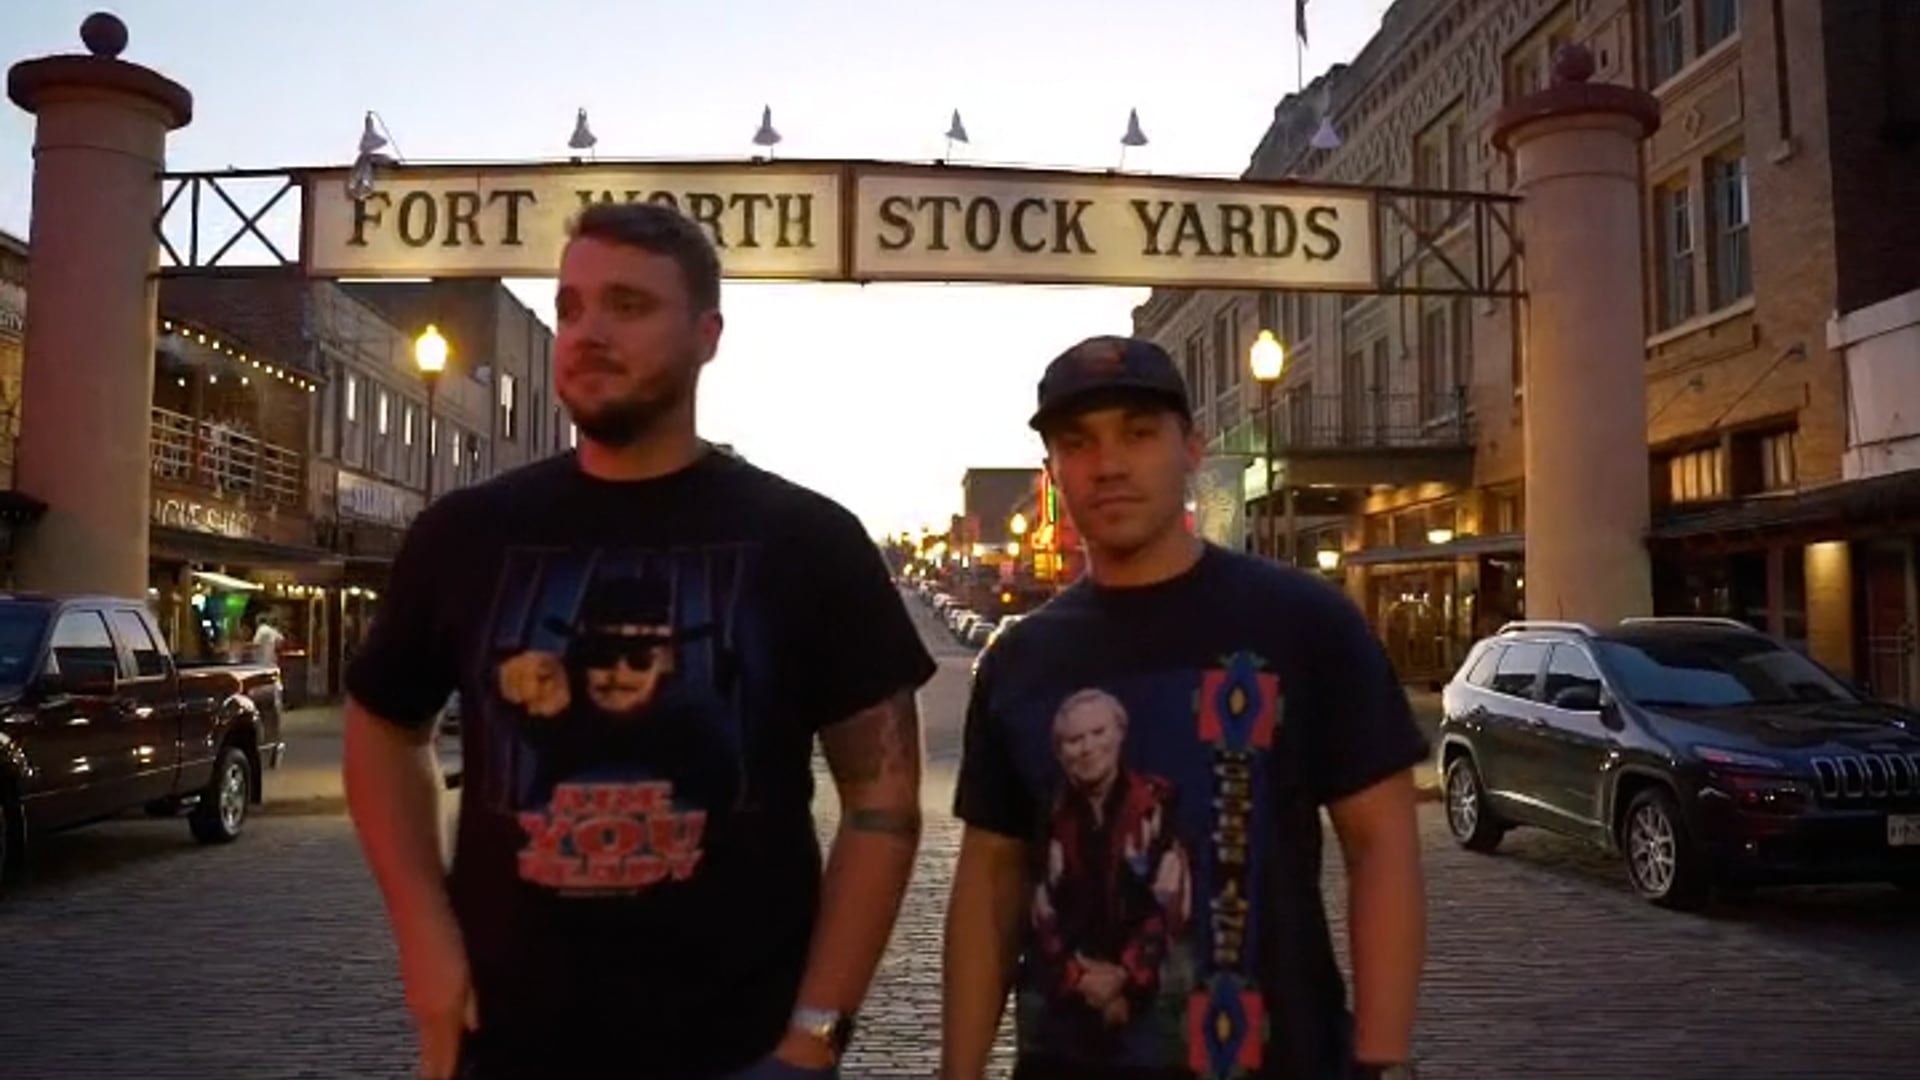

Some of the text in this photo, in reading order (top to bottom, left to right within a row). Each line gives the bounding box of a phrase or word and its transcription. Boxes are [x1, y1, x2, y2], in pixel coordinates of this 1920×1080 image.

[346, 190, 1342, 261] FORT RTH STOCK YARDS
[517, 811, 707, 863] YOU
